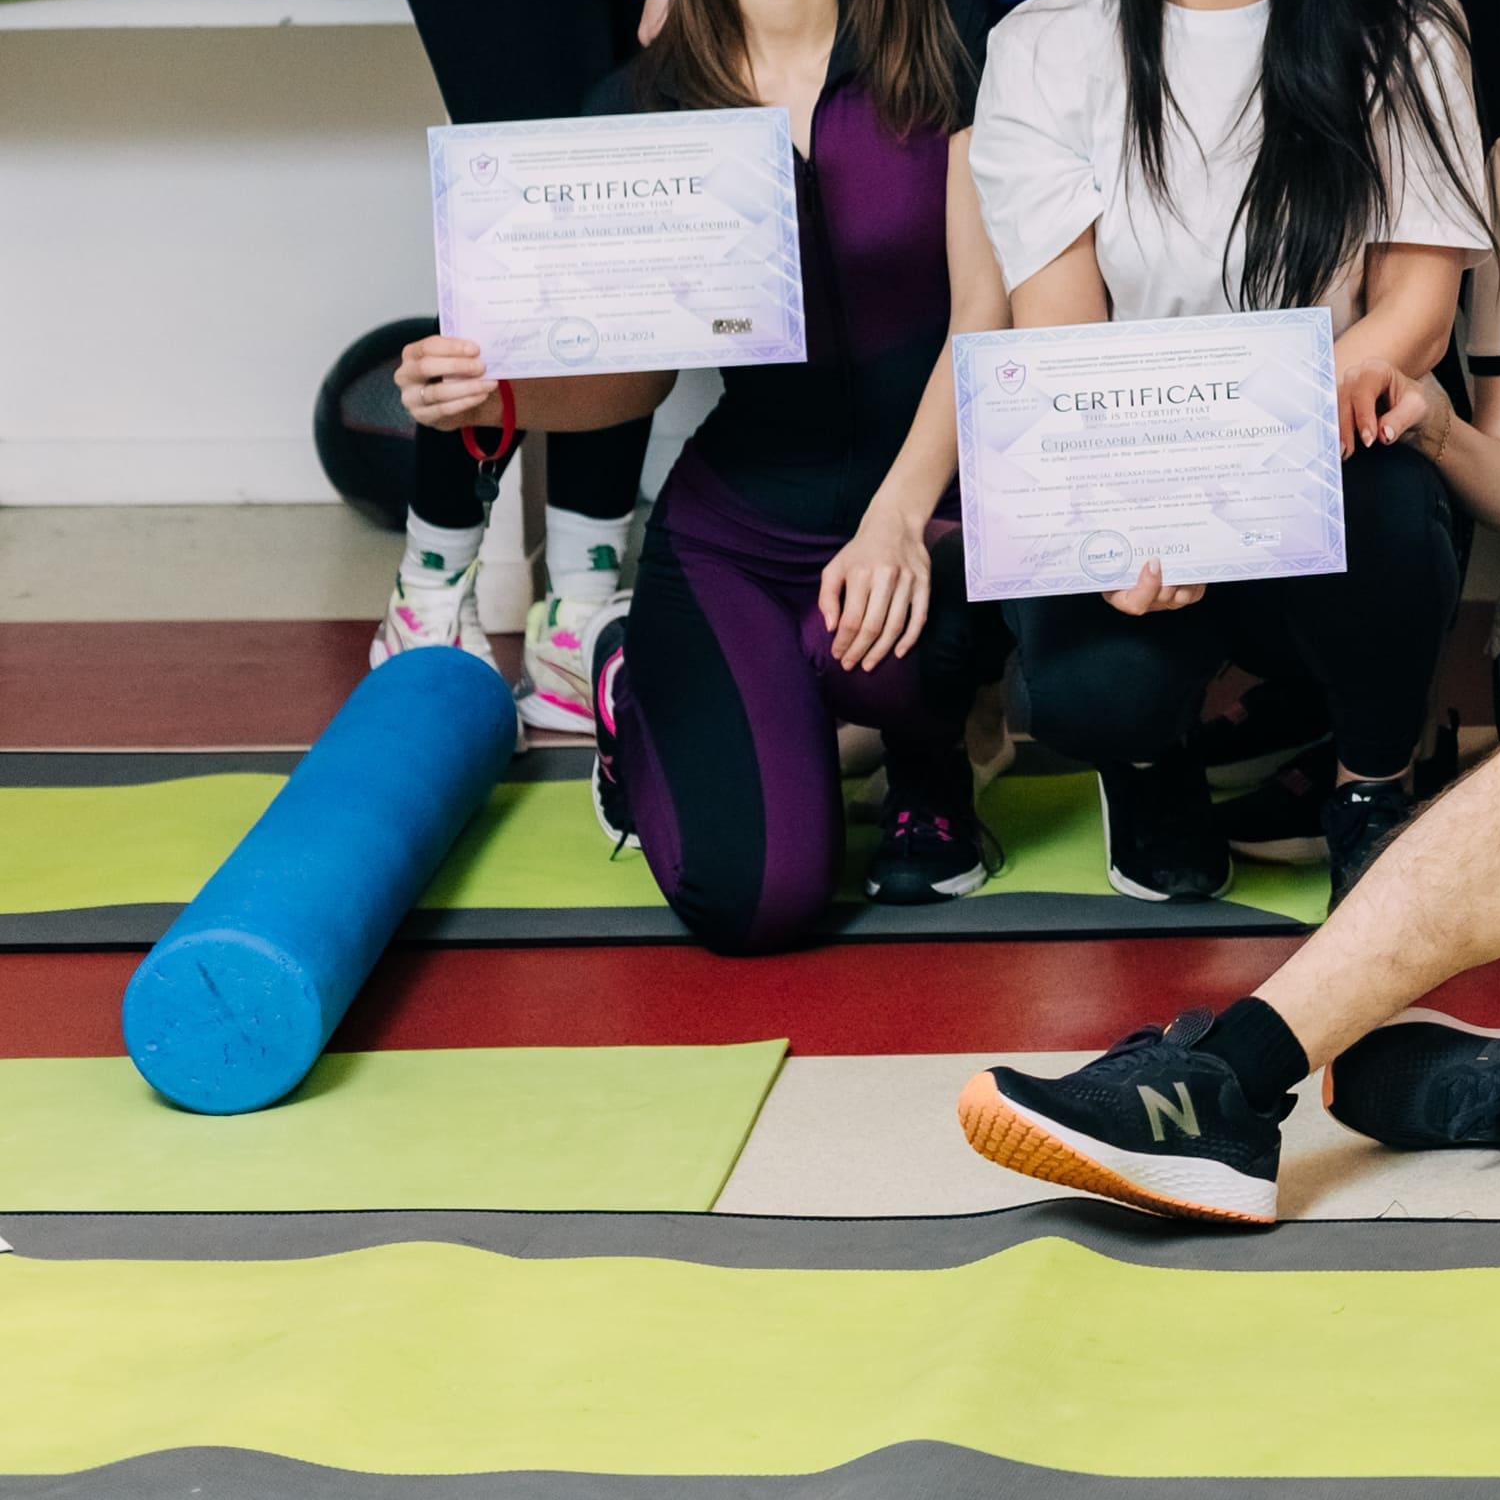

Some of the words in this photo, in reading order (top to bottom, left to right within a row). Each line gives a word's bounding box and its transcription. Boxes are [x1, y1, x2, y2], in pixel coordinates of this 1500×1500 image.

[521, 175, 703, 204] CERTIFICATE
[1051, 379, 1241, 414] CERTIFICATE
[1084, 413, 1107, 422] THIS
[1111, 412, 1120, 420] IS
[1123, 410, 1138, 419] TO
[1140, 407, 1181, 418] CERTIFY
[1185, 405, 1210, 414] THAT
[1040, 432, 1136, 454] Строителева
[1140, 429, 1177, 445] Анна
[1181, 420, 1293, 444] Александровна
[1135, 1080, 1203, 1143] N
